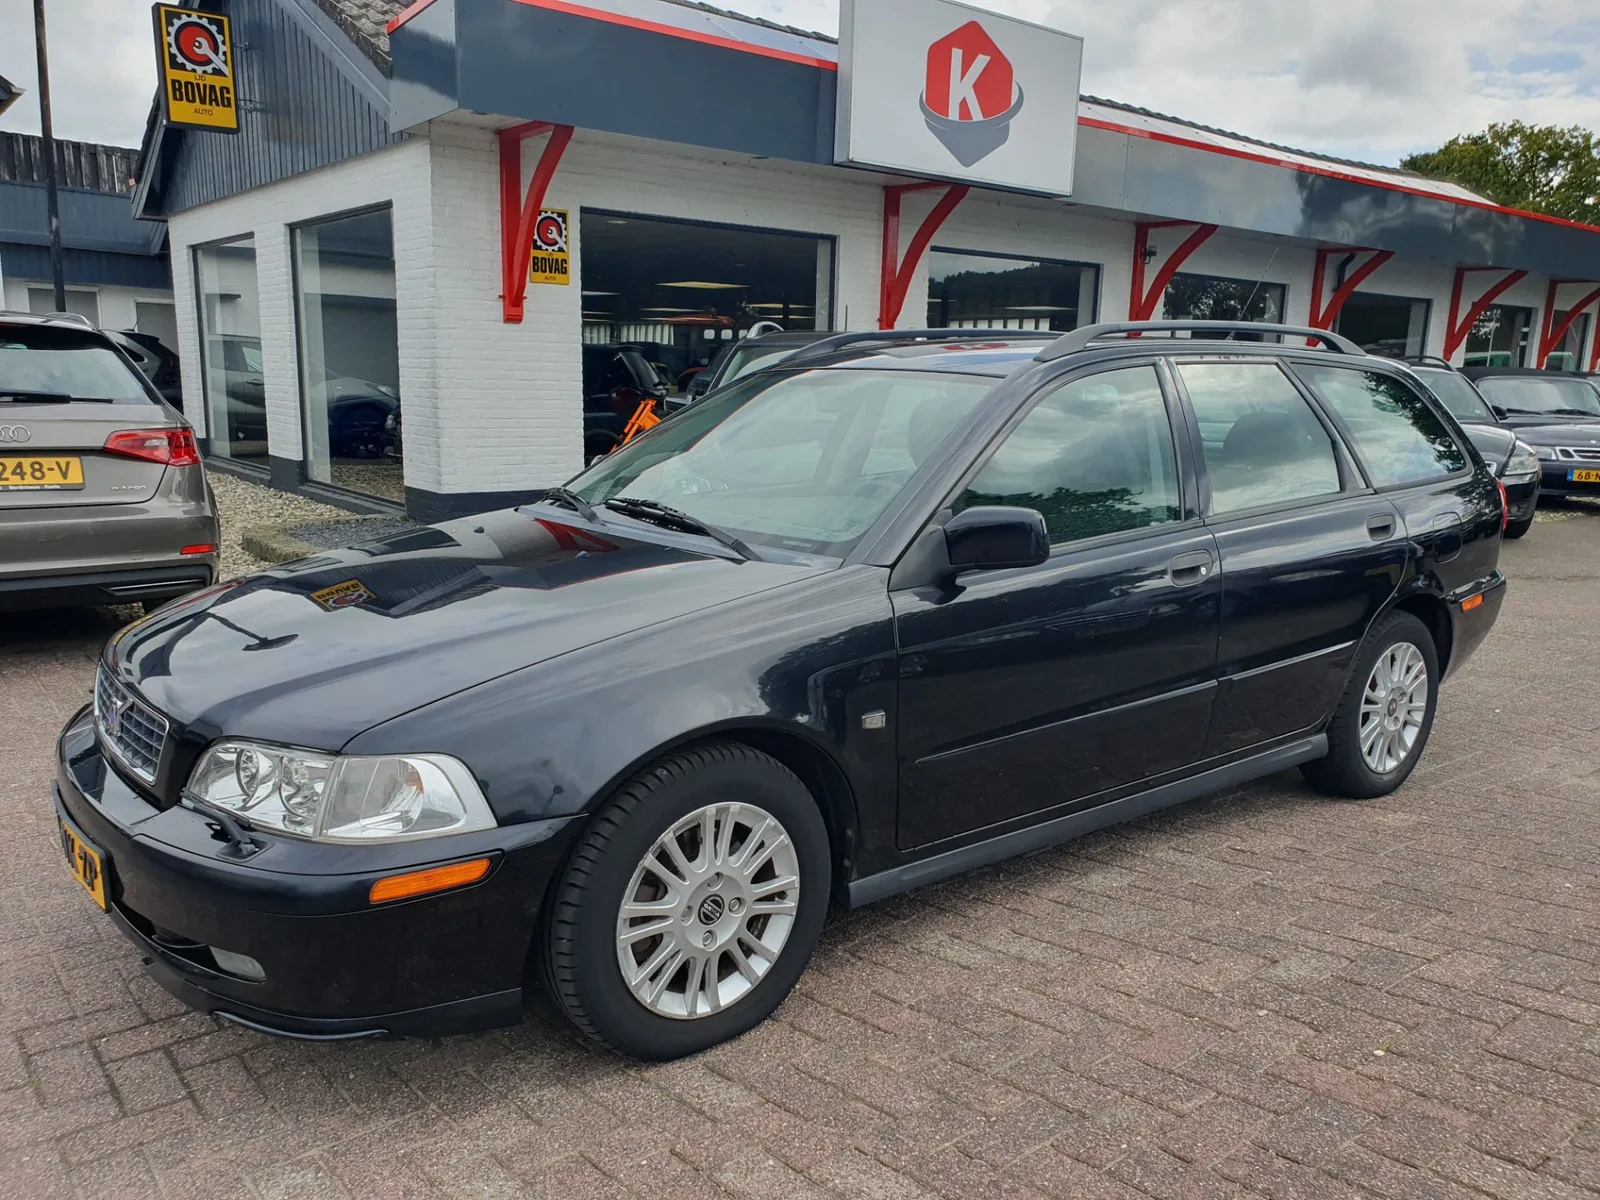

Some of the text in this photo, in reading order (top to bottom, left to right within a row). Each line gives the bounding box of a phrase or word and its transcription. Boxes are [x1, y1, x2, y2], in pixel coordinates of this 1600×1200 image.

[171, 78, 232, 109] BOVAG
[948, 47, 991, 121] K
[193, 107, 214, 116] AUTO
[532, 256, 567, 275] BOVAG
[0, 461, 70, 481] 248-V
